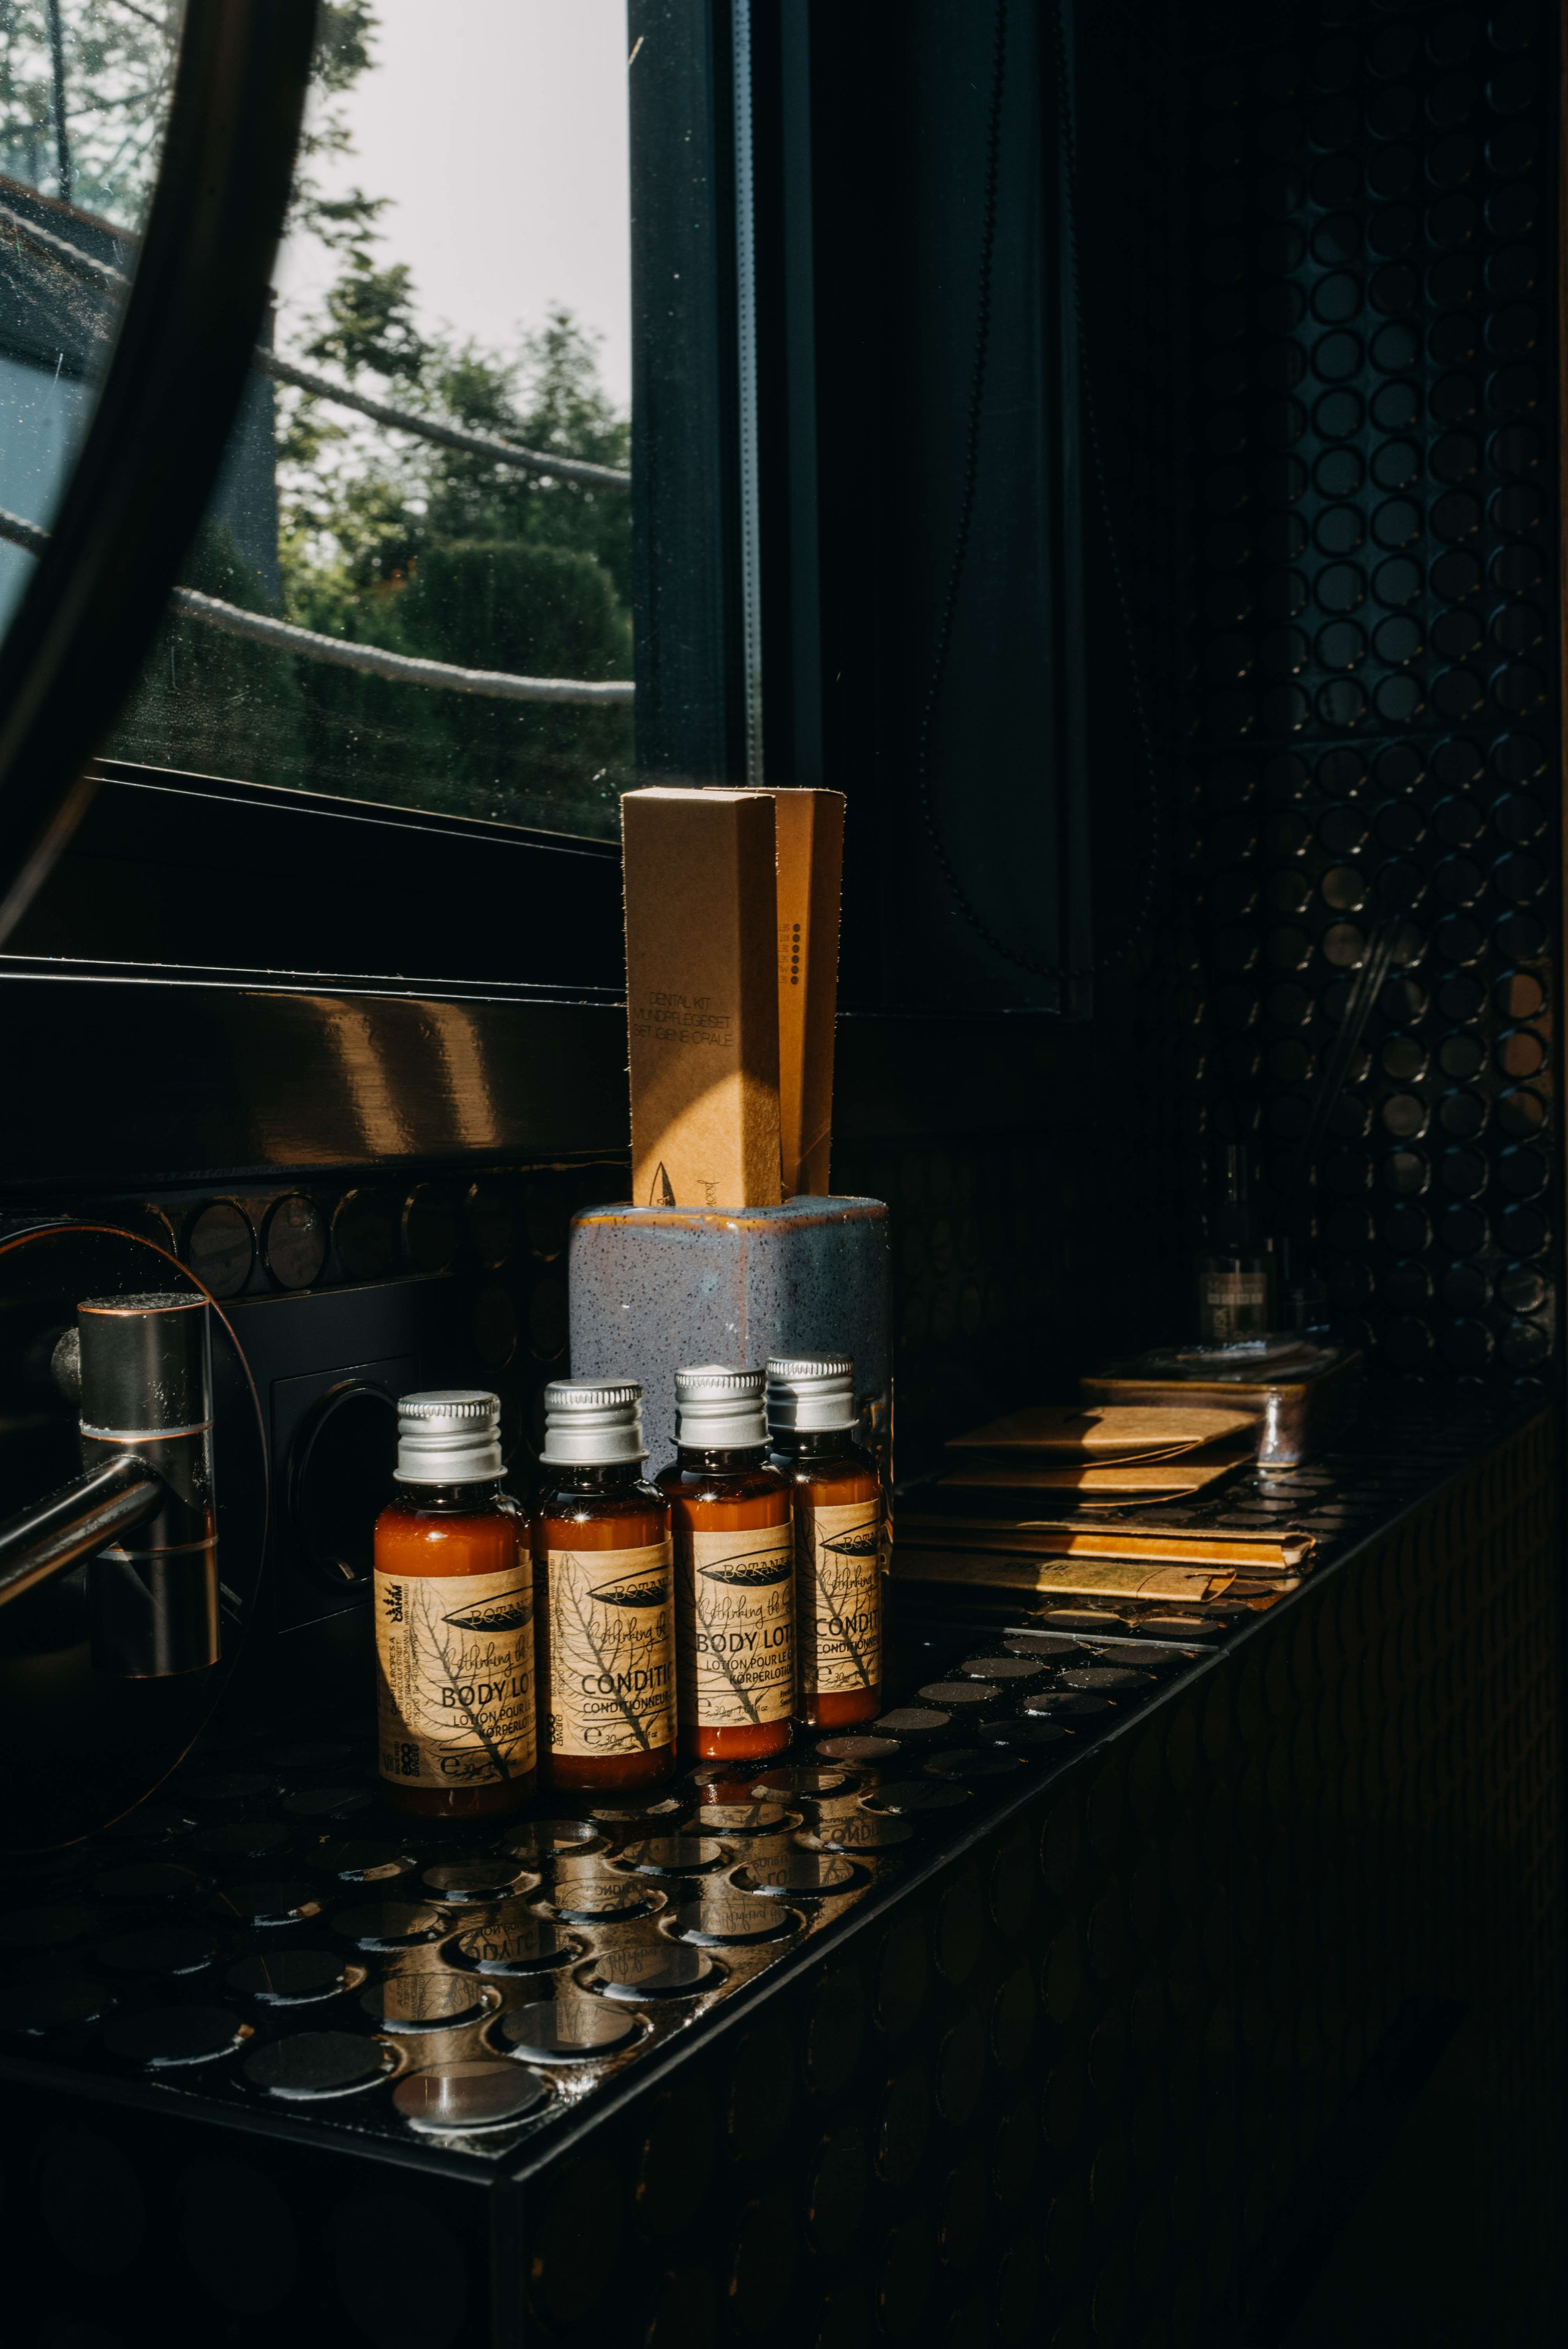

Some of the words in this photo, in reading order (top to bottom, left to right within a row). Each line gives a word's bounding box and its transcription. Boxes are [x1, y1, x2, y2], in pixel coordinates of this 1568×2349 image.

[650, 992, 692, 1009] DENTAL
[693, 997, 711, 1011] KIT
[633, 1007, 731, 1029] MUNDPFLEGESET
[633, 1024, 652, 1038] SET
[692, 1031, 733, 1047] ORALE
[392, 1585, 403, 1623] CAHM
[696, 1631, 758, 1653] BODY
[706, 1659, 747, 1670] LOTION
[750, 1655, 777, 1668] POUR
[778, 1651, 787, 1664] LE
[442, 1680, 507, 1708] BODY
[453, 1711, 497, 1726] LOTION
[499, 1703, 524, 1721] POUR
[401, 1743, 412, 1776] eco
[411, 1744, 420, 1777] aware
